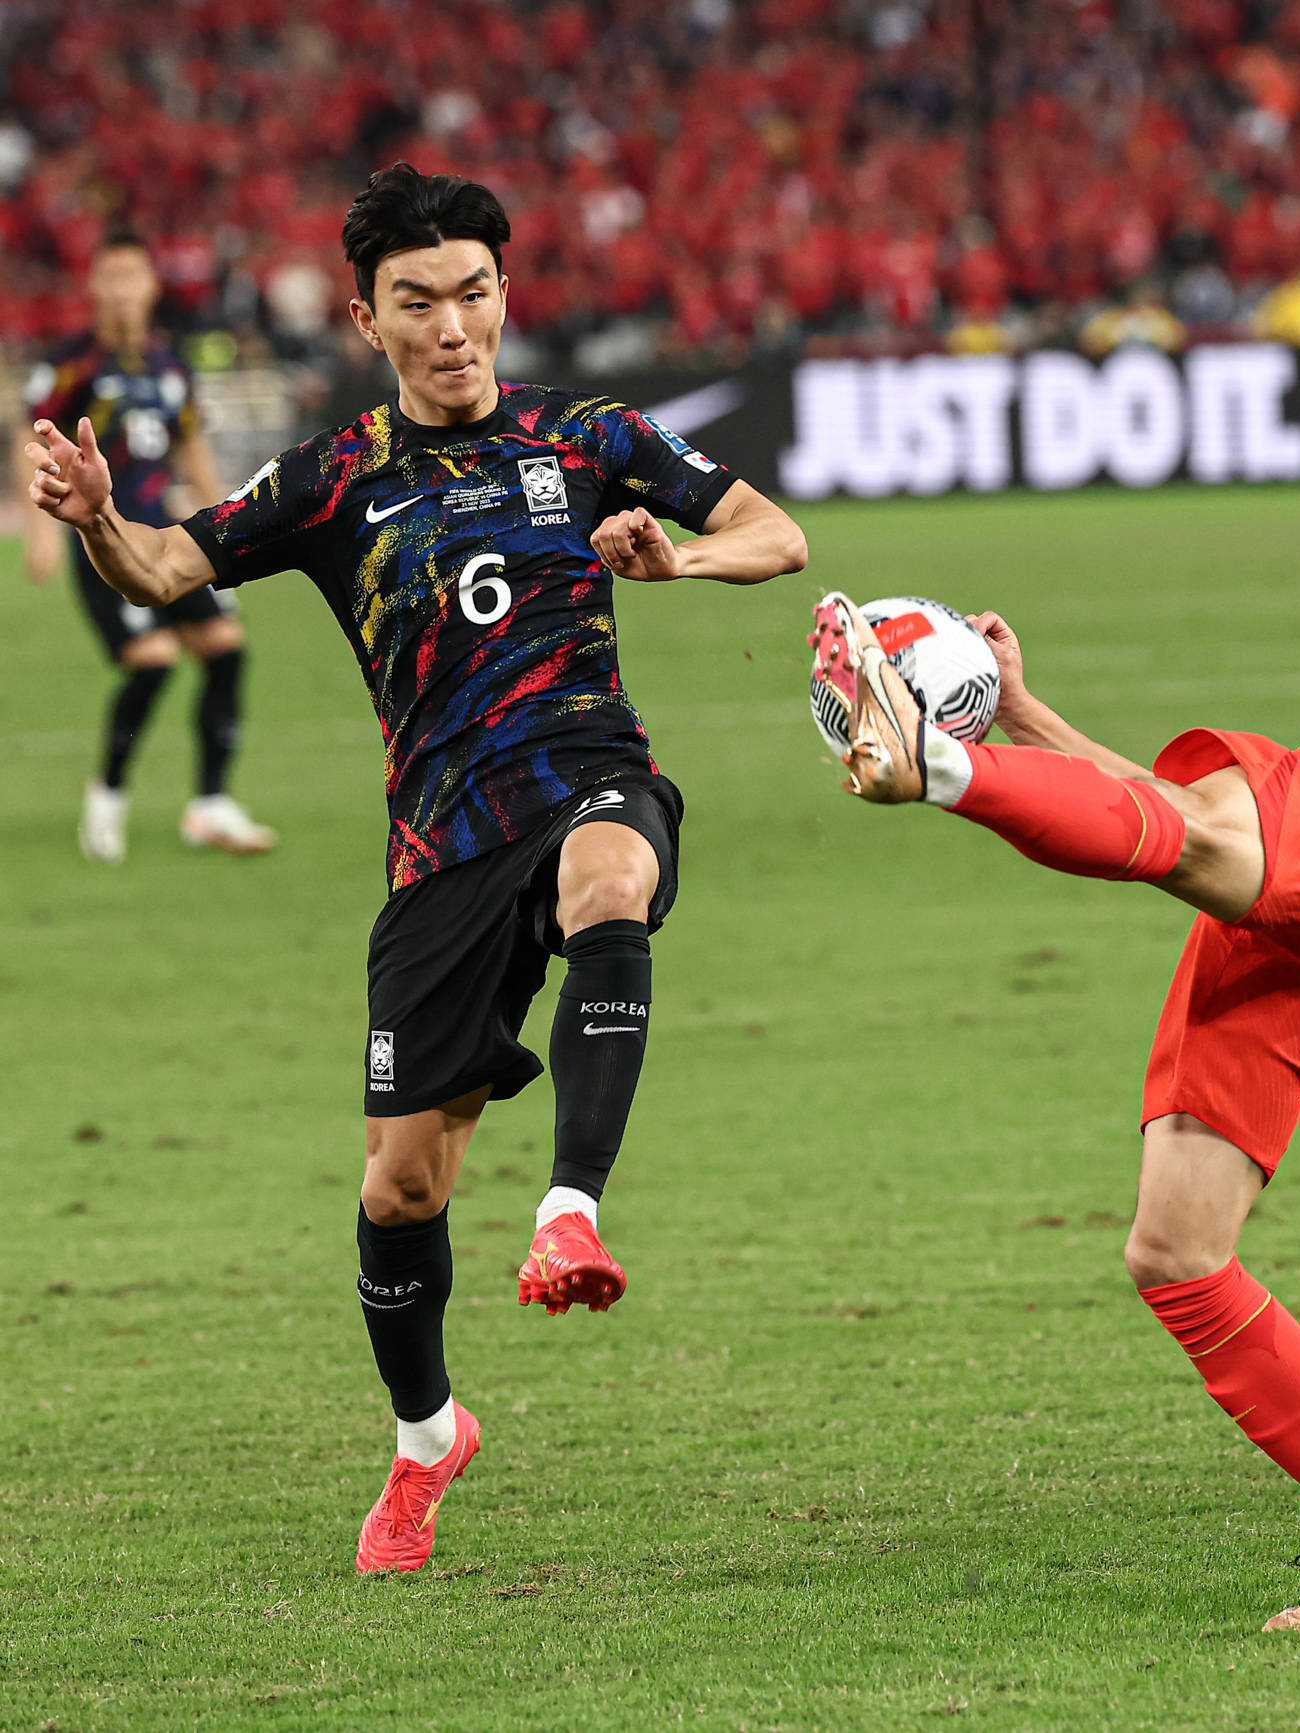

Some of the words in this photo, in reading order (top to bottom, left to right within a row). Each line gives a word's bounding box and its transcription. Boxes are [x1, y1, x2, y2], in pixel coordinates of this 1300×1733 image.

[778, 355, 1014, 499] JUST
[1019, 350, 1184, 489] DO
[530, 512, 571, 527] KOREA
[458, 552, 512, 626] 6
[580, 1001, 647, 1018] KOREA
